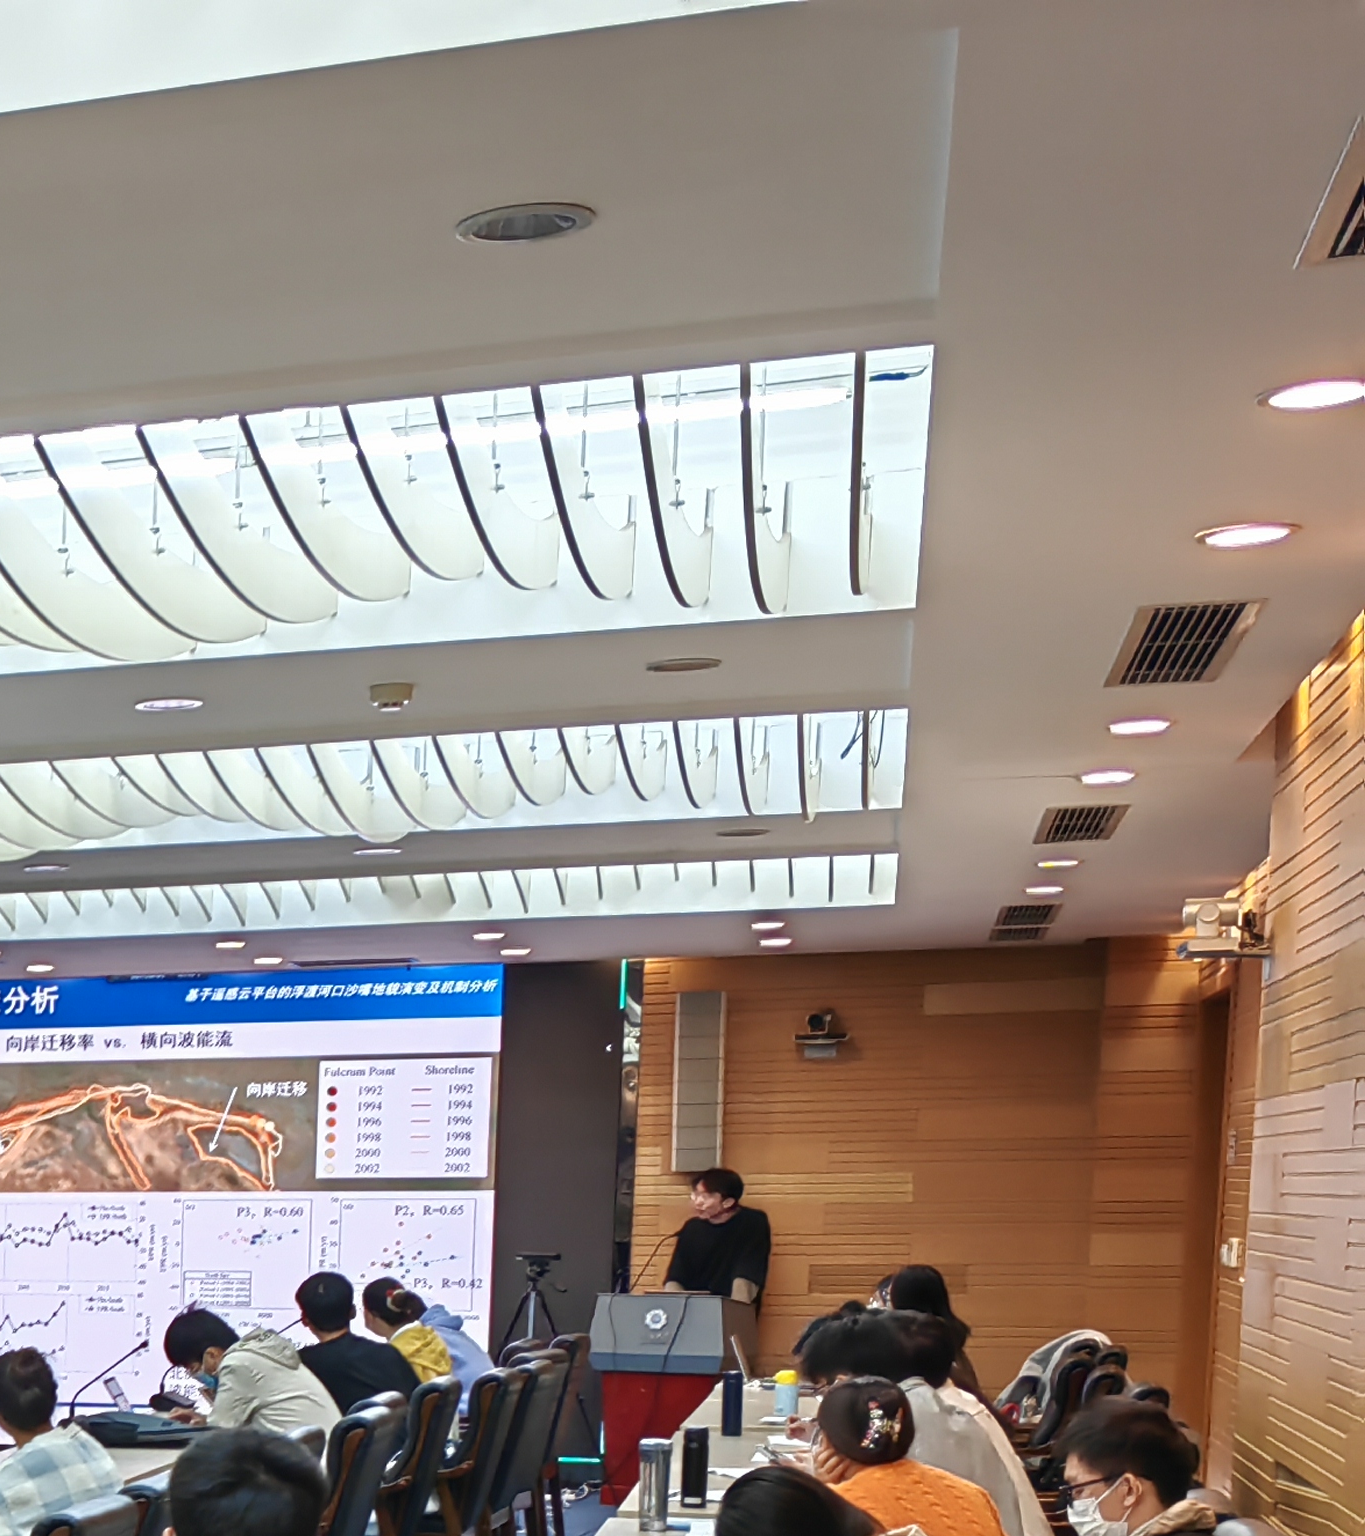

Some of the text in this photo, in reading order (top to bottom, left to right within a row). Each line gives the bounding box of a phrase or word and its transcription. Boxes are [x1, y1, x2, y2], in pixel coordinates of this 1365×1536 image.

[140, 1030, 234, 1049] 横向波能流
[324, 1066, 396, 1077] Fulcrum Point
[424, 1065, 475, 1076] Shoreline
[246, 1081, 308, 1099] 向岸迁移
[358, 1085, 383, 1096] 1992
[448, 1084, 473, 1094] 1992
[357, 1101, 382, 1112] 1994
[447, 1099, 473, 1110] 1994
[357, 1117, 382, 1127] 1996
[447, 1115, 473, 1126] 1996
[356, 1132, 382, 1143] 1998
[446, 1131, 472, 1142] 1998
[355, 1148, 381, 1158] 2000
[444, 1147, 471, 1158] 2000
[354, 1163, 380, 1174] 2002
[444, 1162, 470, 1173] 2002
